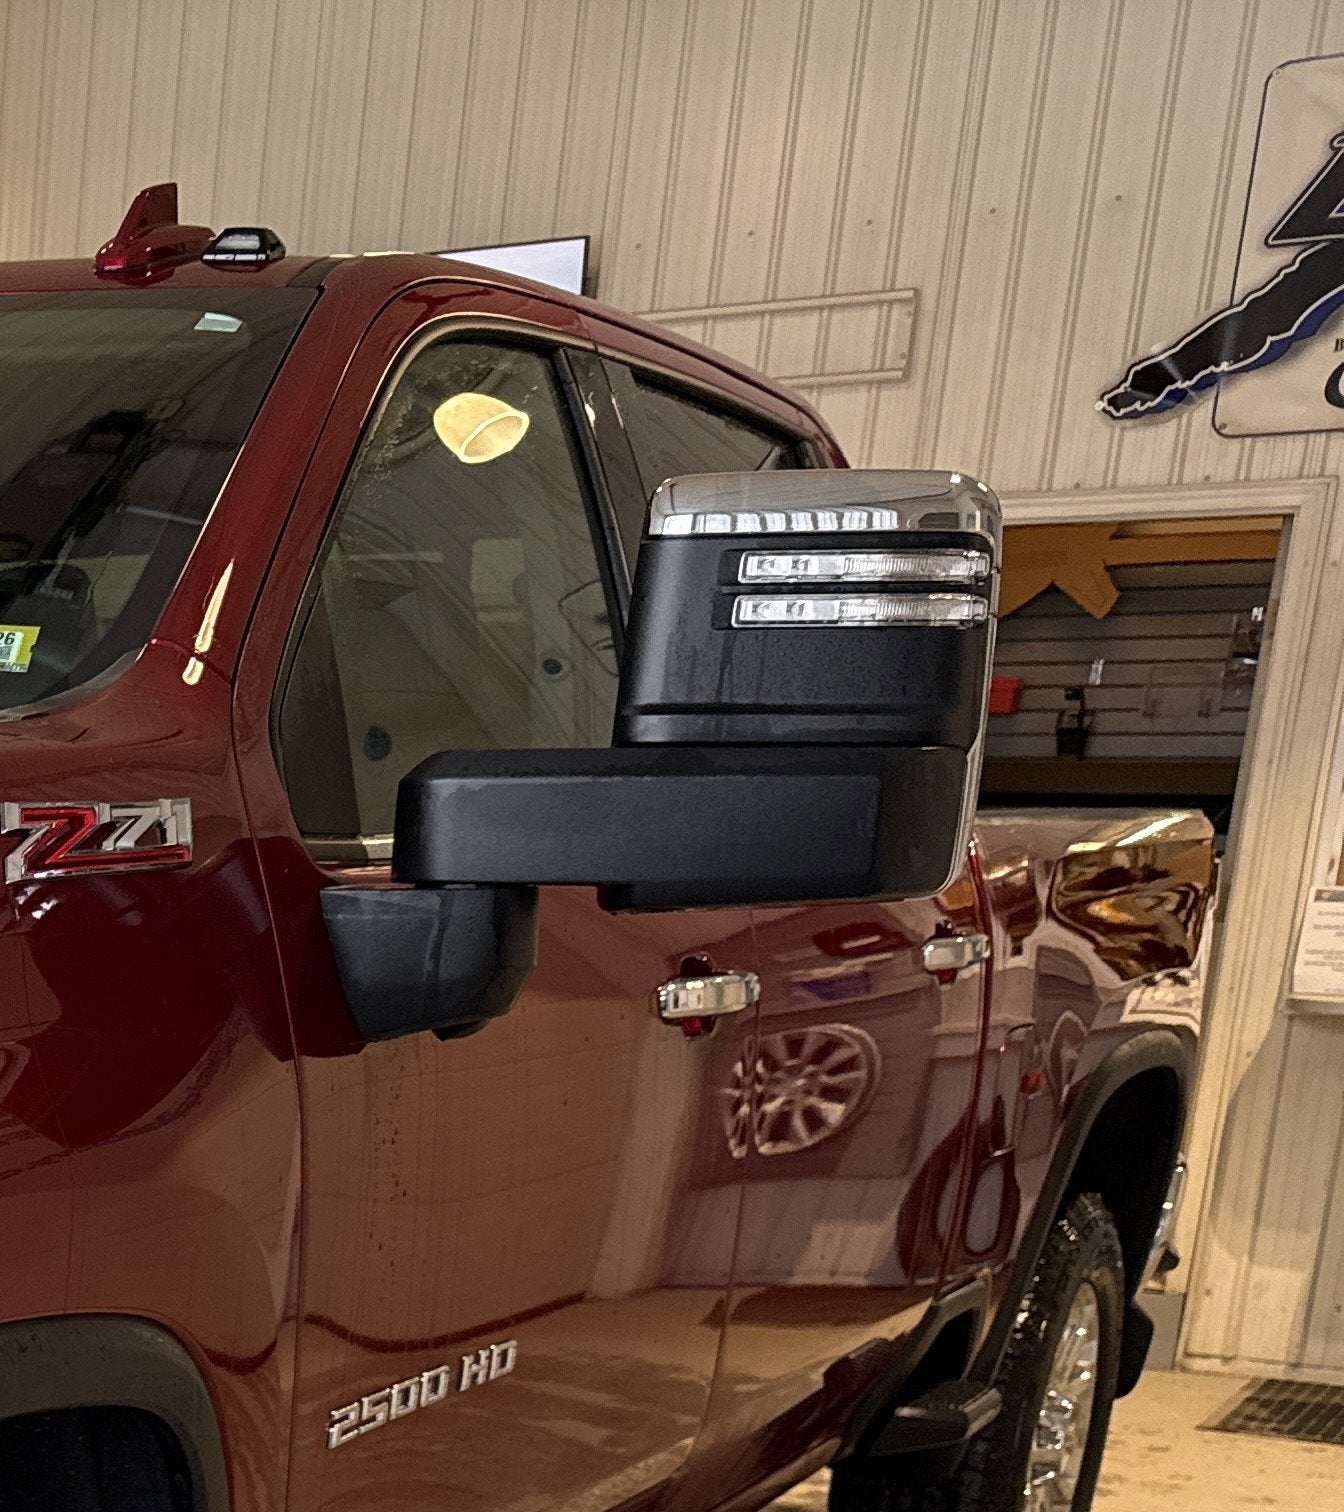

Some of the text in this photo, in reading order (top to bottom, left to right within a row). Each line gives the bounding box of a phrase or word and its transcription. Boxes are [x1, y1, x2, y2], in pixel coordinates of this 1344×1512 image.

[0, 798, 193, 884] Z71
[327, 1340, 517, 1449] 2500 HD
